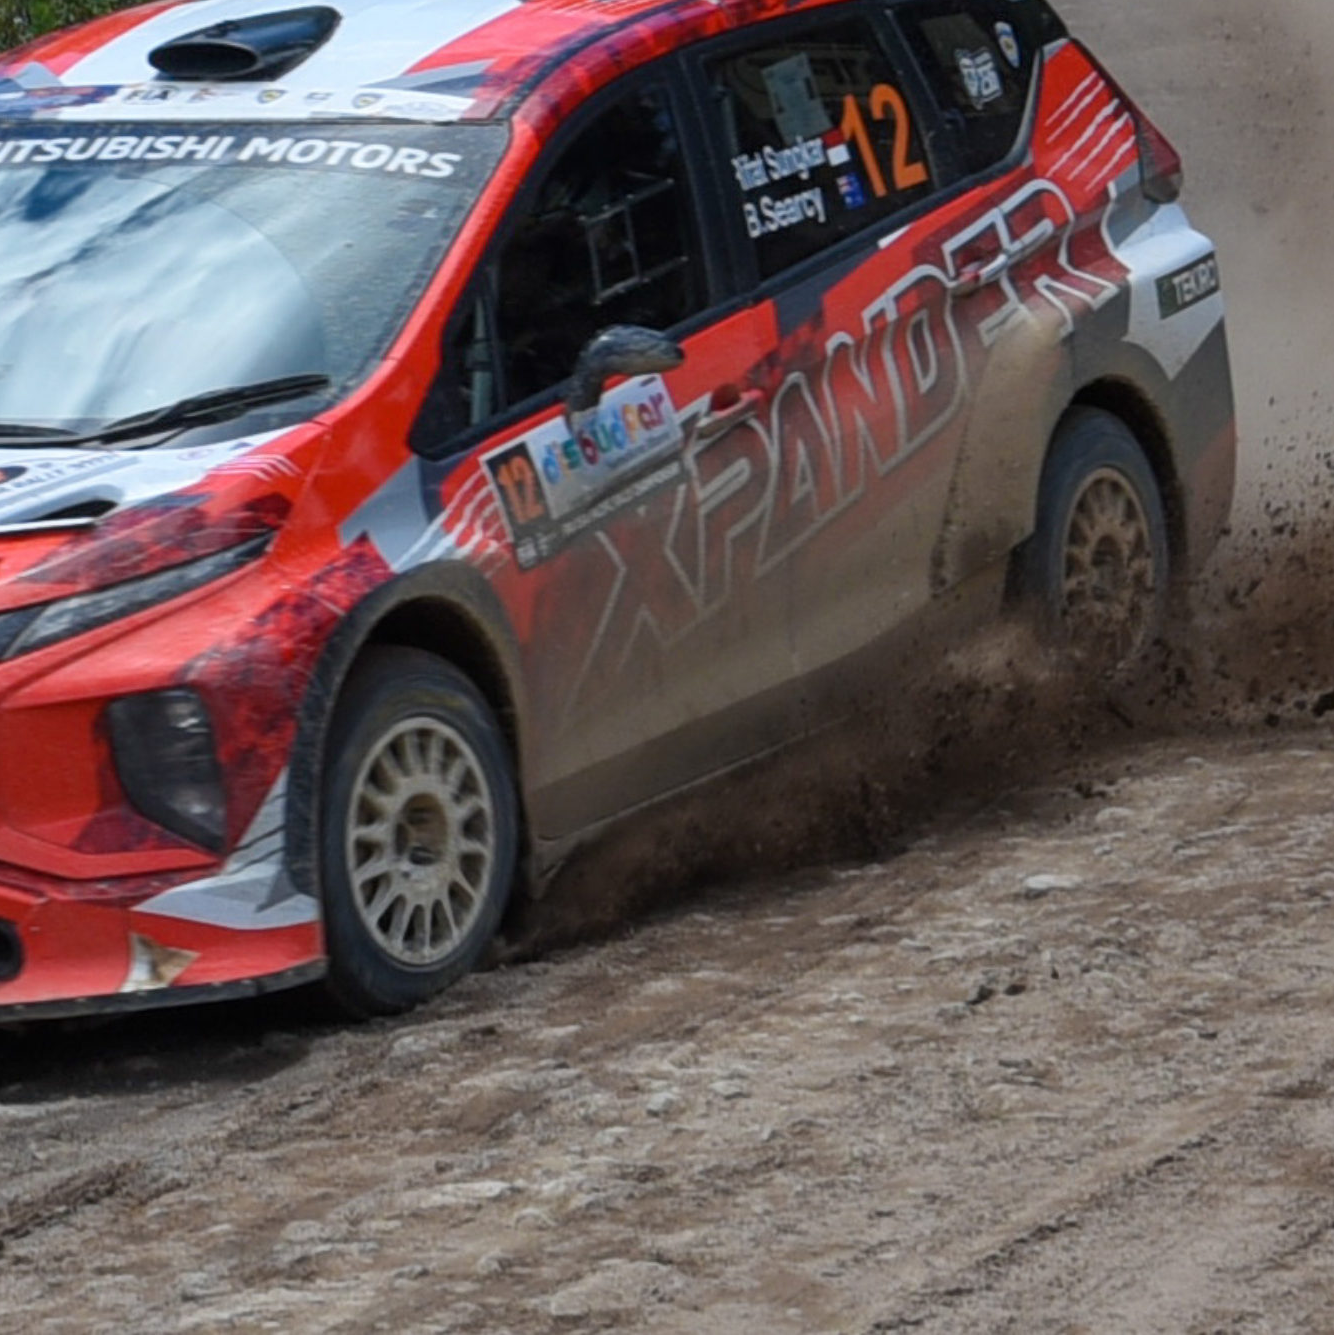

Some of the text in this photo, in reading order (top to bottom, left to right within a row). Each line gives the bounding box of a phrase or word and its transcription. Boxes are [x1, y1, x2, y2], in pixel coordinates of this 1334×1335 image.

[238, 136, 463, 179] MOTORS
[841, 83, 929, 198] 12
[743, 187, 826, 239] B.Searcy
[496, 455, 547, 525] 12
[562, 179, 1117, 731] XPANDER
